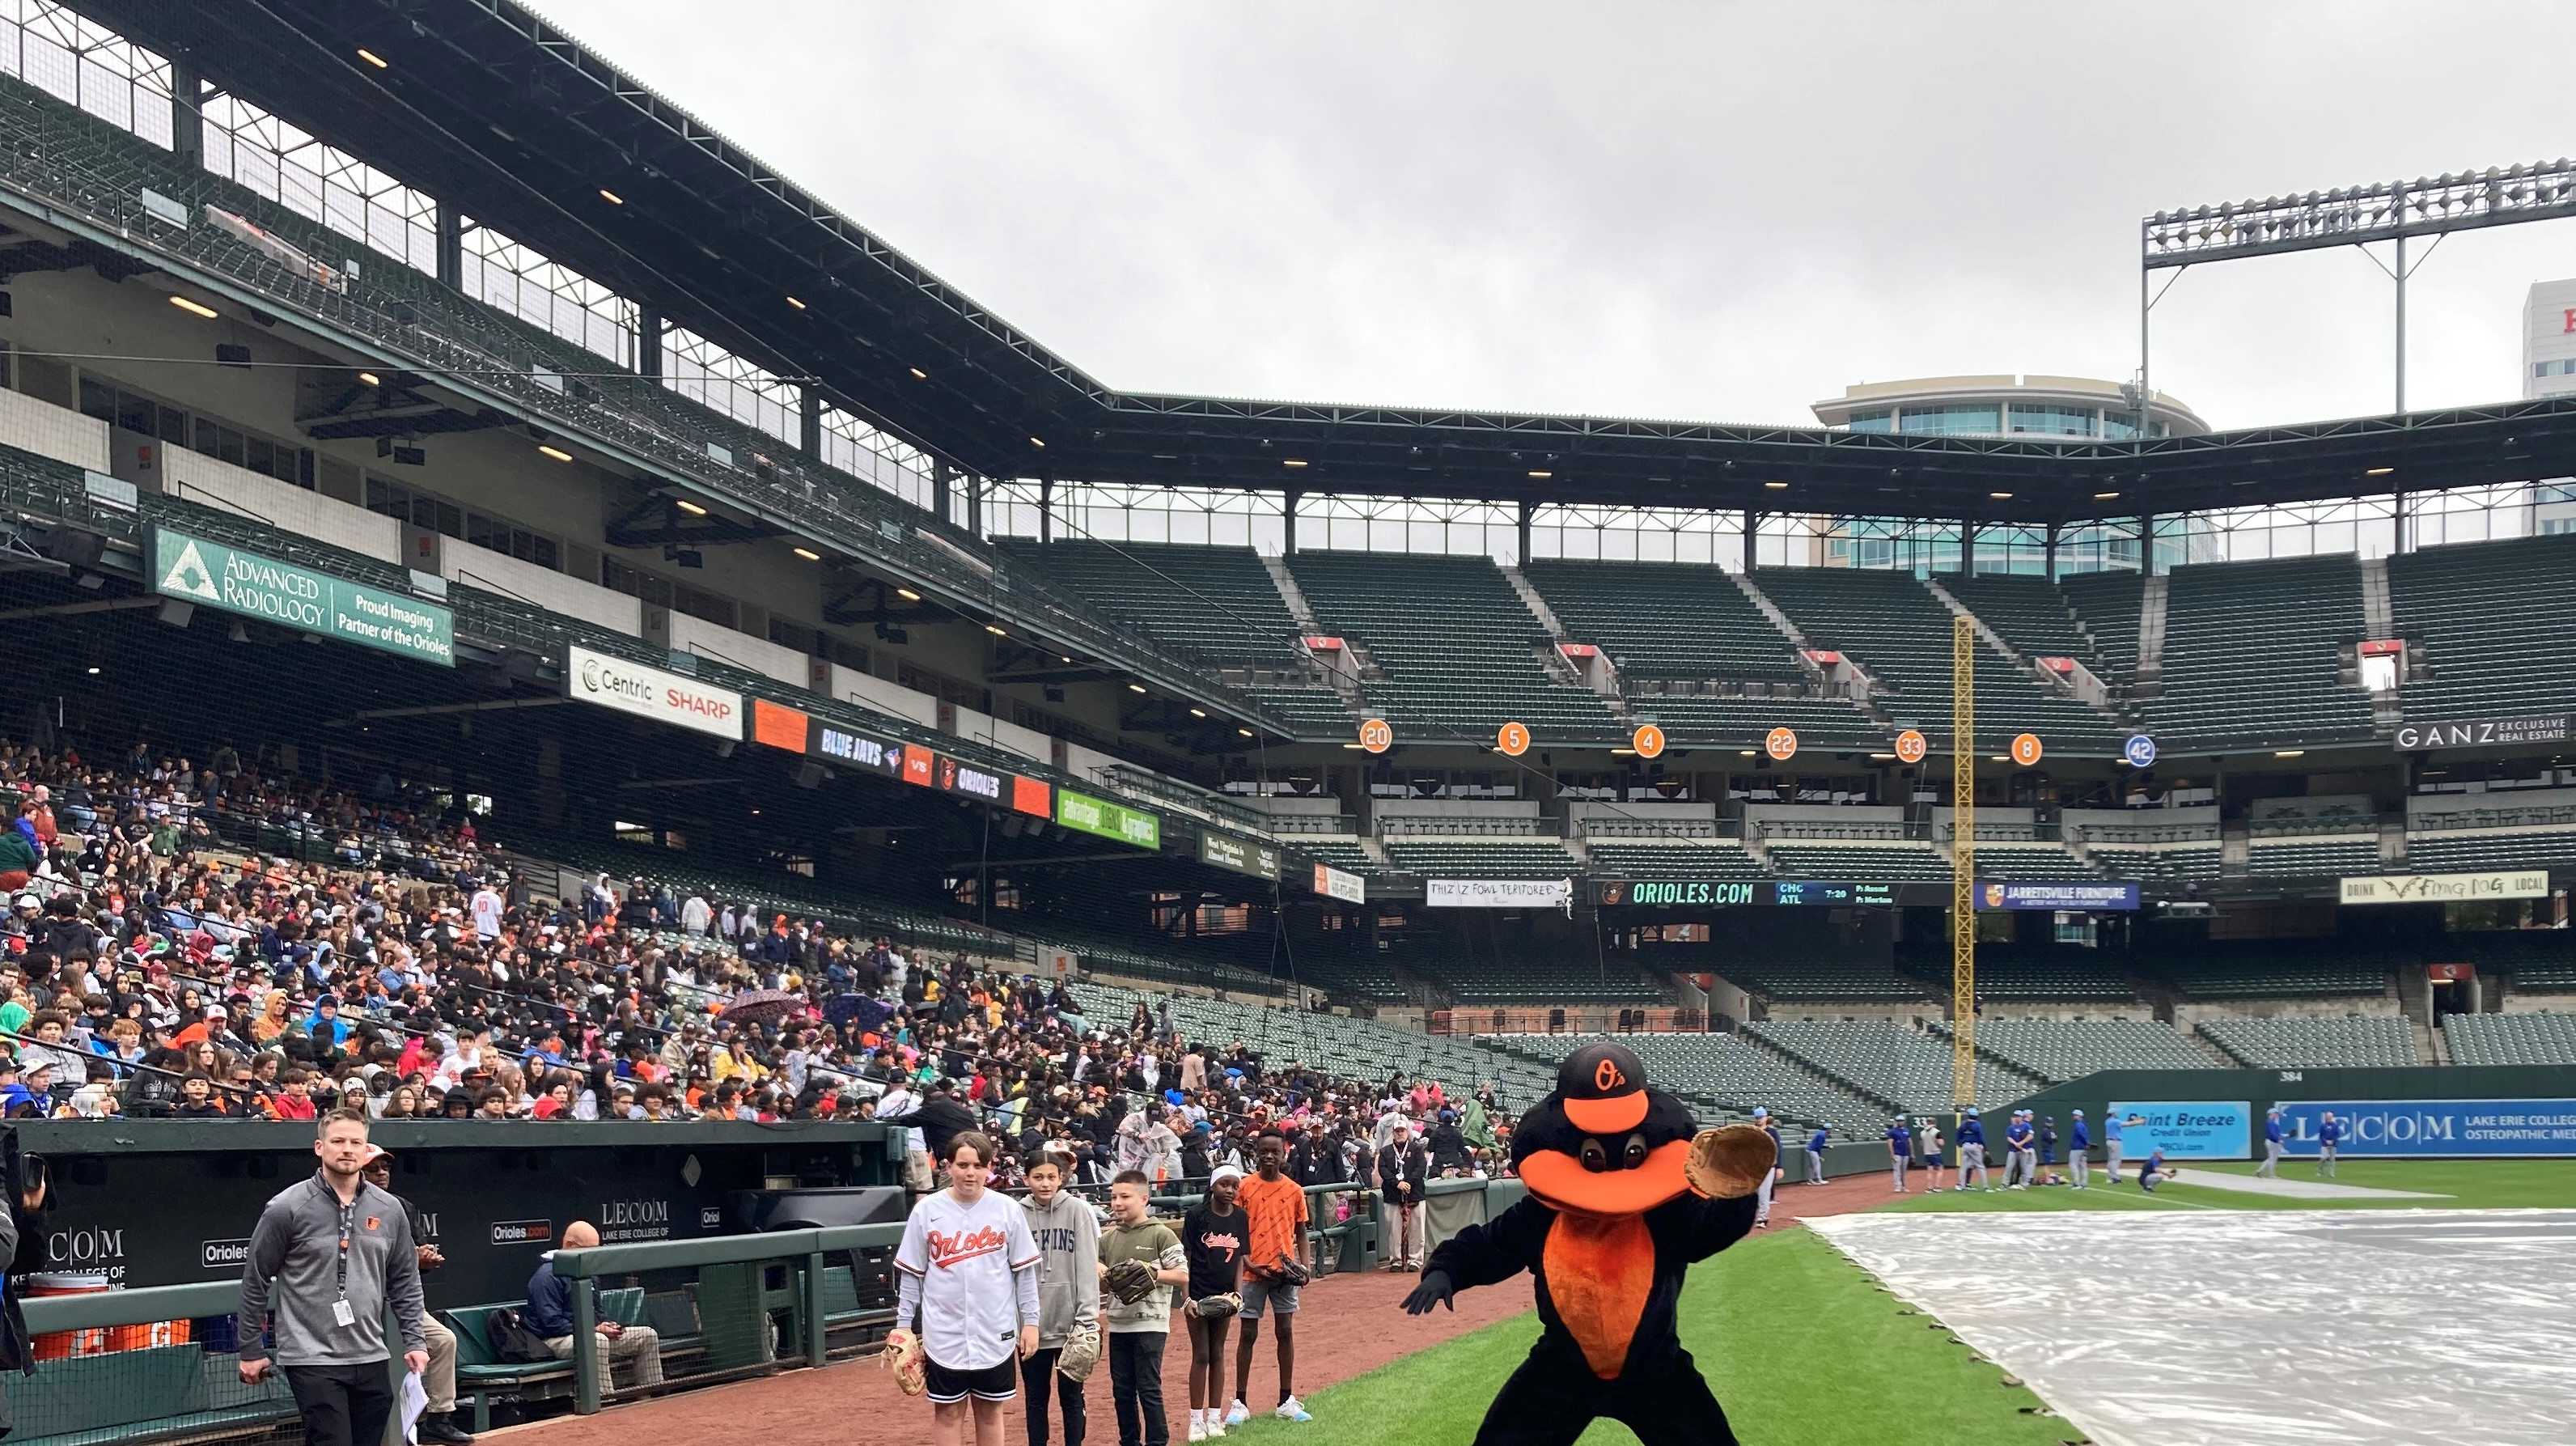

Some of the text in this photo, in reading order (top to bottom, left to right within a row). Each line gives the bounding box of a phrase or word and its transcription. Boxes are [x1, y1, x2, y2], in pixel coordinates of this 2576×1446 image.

[224, 552, 319, 599] ADVANCED
[224, 580, 324, 627] RADIOLOGY
[356, 595, 434, 630] Proud Imaging
[339, 613, 450, 657] Partner of the Orioles
[602, 669, 652, 700] Centric
[667, 689, 731, 719] SHARP
[2499, 718, 2566, 731] EXCLUSIVE
[1365, 727, 1389, 745] 20
[1509, 730, 1519, 748] 5
[1643, 734, 1655, 751] 4
[1771, 735, 1793, 753] 22
[2398, 723, 2495, 748] GANZ
[2499, 729, 2566, 742] REAL ESTATE
[821, 728, 882, 766] BLUE JAYS
[1901, 738, 1922, 756] 33
[2022, 740, 2033, 757] 8
[2130, 743, 2151, 760] 42
[958, 768, 1000, 798] ORIOLES
[1431, 884, 1454, 894] THIZ
[1780, 884, 1804, 893] CHC
[2347, 883, 2375, 897] DRINK
[2515, 877, 2544, 891] LOCAL
[1633, 883, 1754, 904] ORIOLES.COM
[1780, 894, 1803, 904] ATL
[1913, 1117, 1927, 1128] 33
[2128, 1113, 2235, 1126] Pint Breeze
[2465, 1115, 2576, 1126] LAKE ERIE COLLEG
[2150, 1129, 2180, 1137] Credit
[2464, 1129, 2576, 1139] OSTEOPATHIC MED
[602, 1200, 668, 1225] LECOM
[494, 1226, 549, 1240] Orioles.com
[602, 1230, 618, 1240] LAKE
[633, 1228, 659, 1238] COLLEGE
[660, 1227, 670, 1236] OF
[1032, 1228, 1075, 1253] KINS
[49, 1228, 125, 1263] COM
[928, 1225, 1006, 1261] Orioles
[205, 1245, 249, 1262] Orioles
[1225, 1249, 1234, 1263] 7
[110, 1266, 125, 1279] OF
